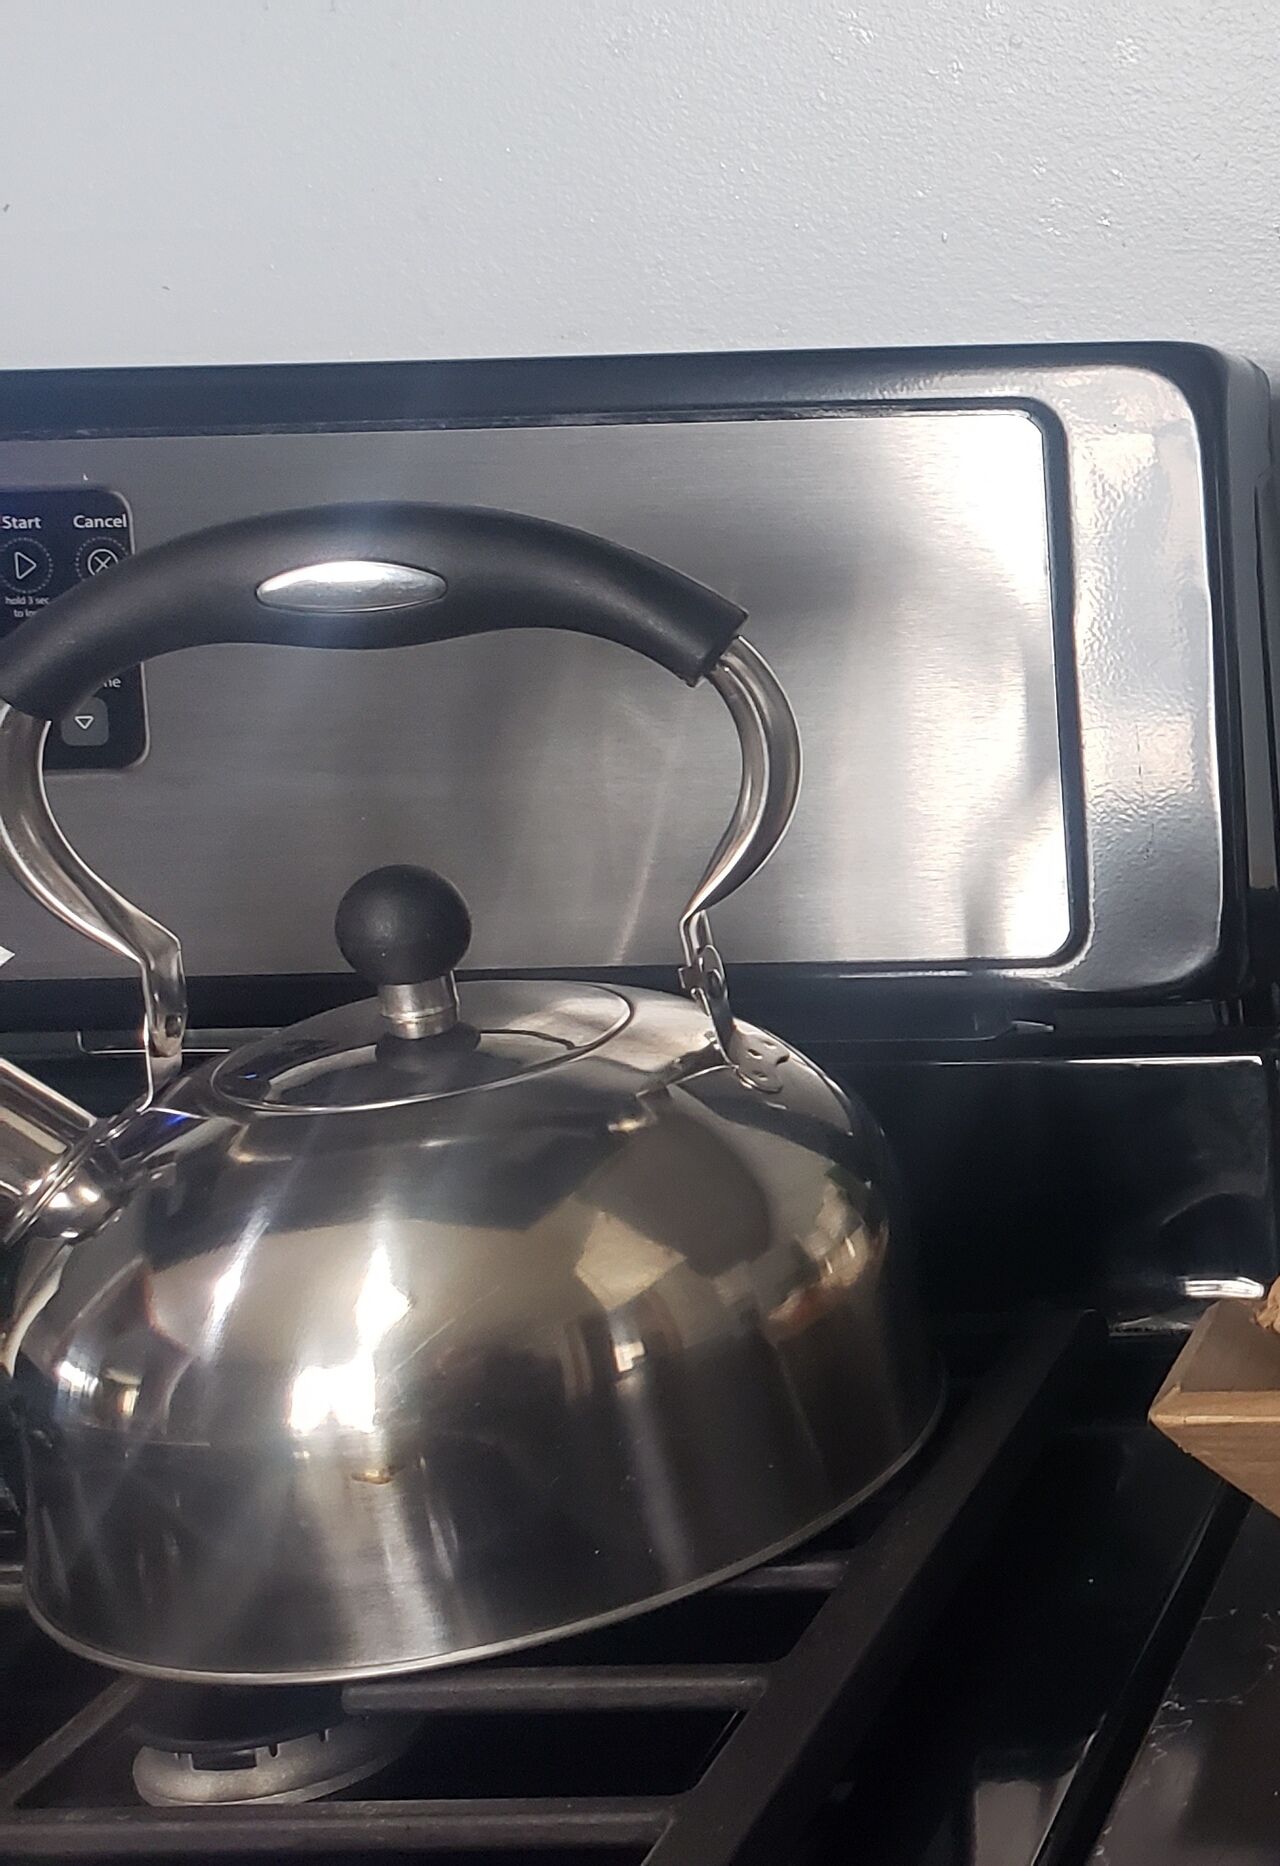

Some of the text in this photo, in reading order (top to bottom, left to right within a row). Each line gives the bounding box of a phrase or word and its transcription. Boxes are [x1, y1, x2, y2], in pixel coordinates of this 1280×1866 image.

[2, 515, 42, 529] Start
[73, 513, 128, 528] Cancel
[5, 596, 26, 605] hold
[13, 609, 24, 618] to
